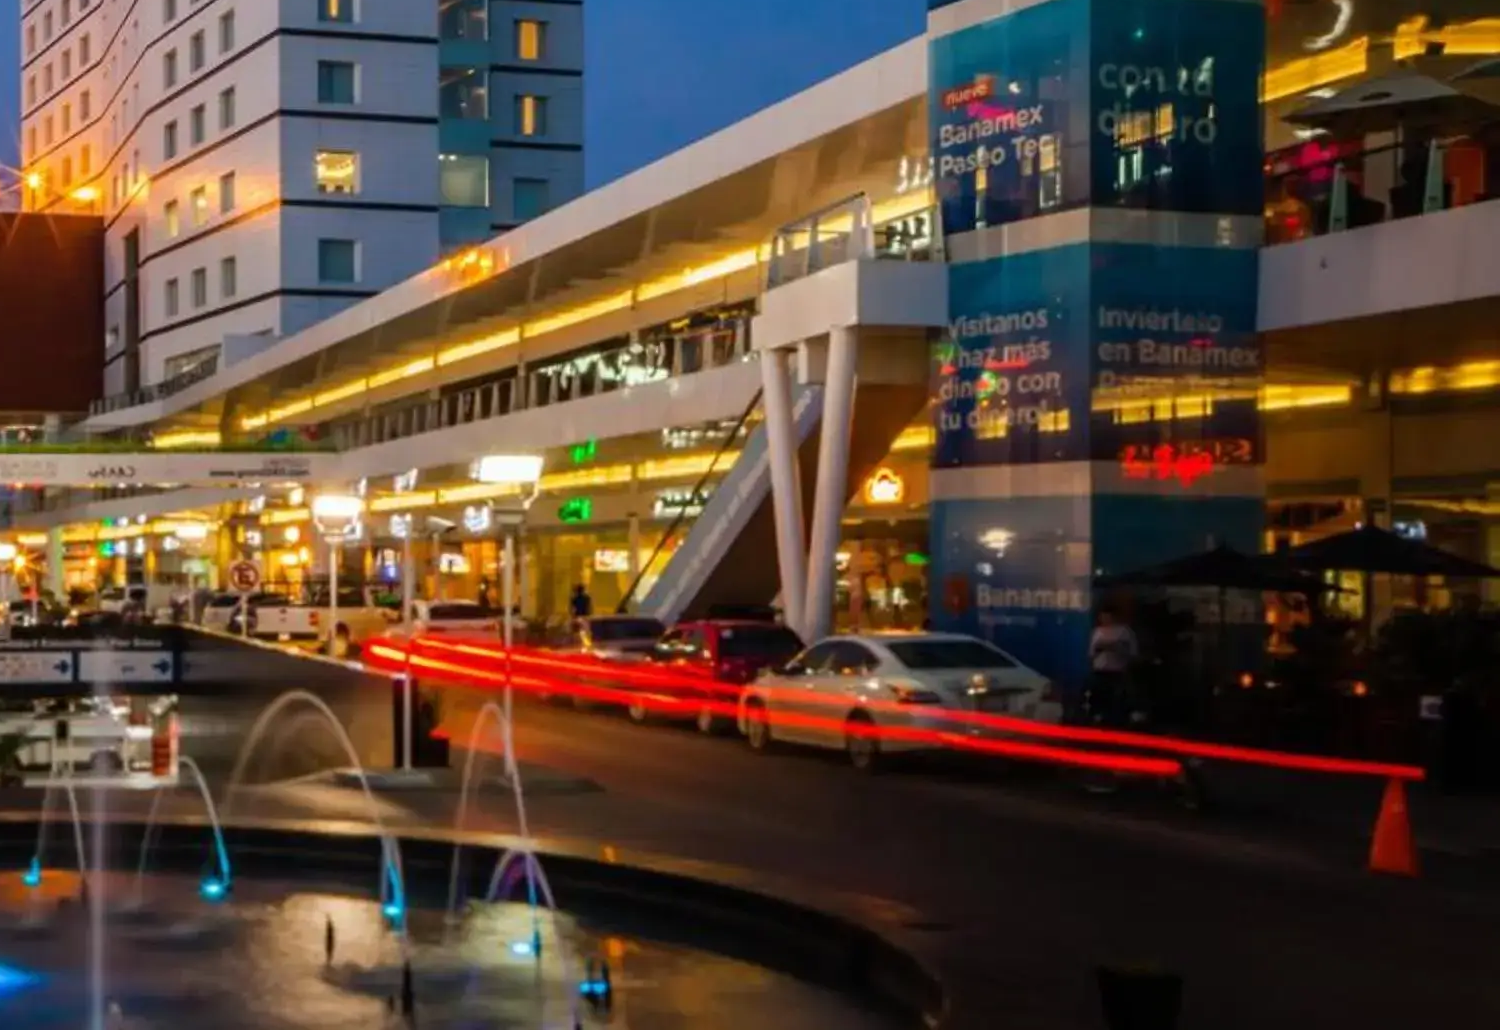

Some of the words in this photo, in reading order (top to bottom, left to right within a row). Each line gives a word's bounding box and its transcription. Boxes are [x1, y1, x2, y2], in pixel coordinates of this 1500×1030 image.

[1099, 63, 1167, 93] con
[940, 104, 1043, 148] Banamex
[959, 346, 996, 368] haz
[1097, 341, 1130, 363] en
[1138, 338, 1258, 367] Banamex
[940, 374, 1010, 401] dino
[1017, 372, 1060, 394] con
